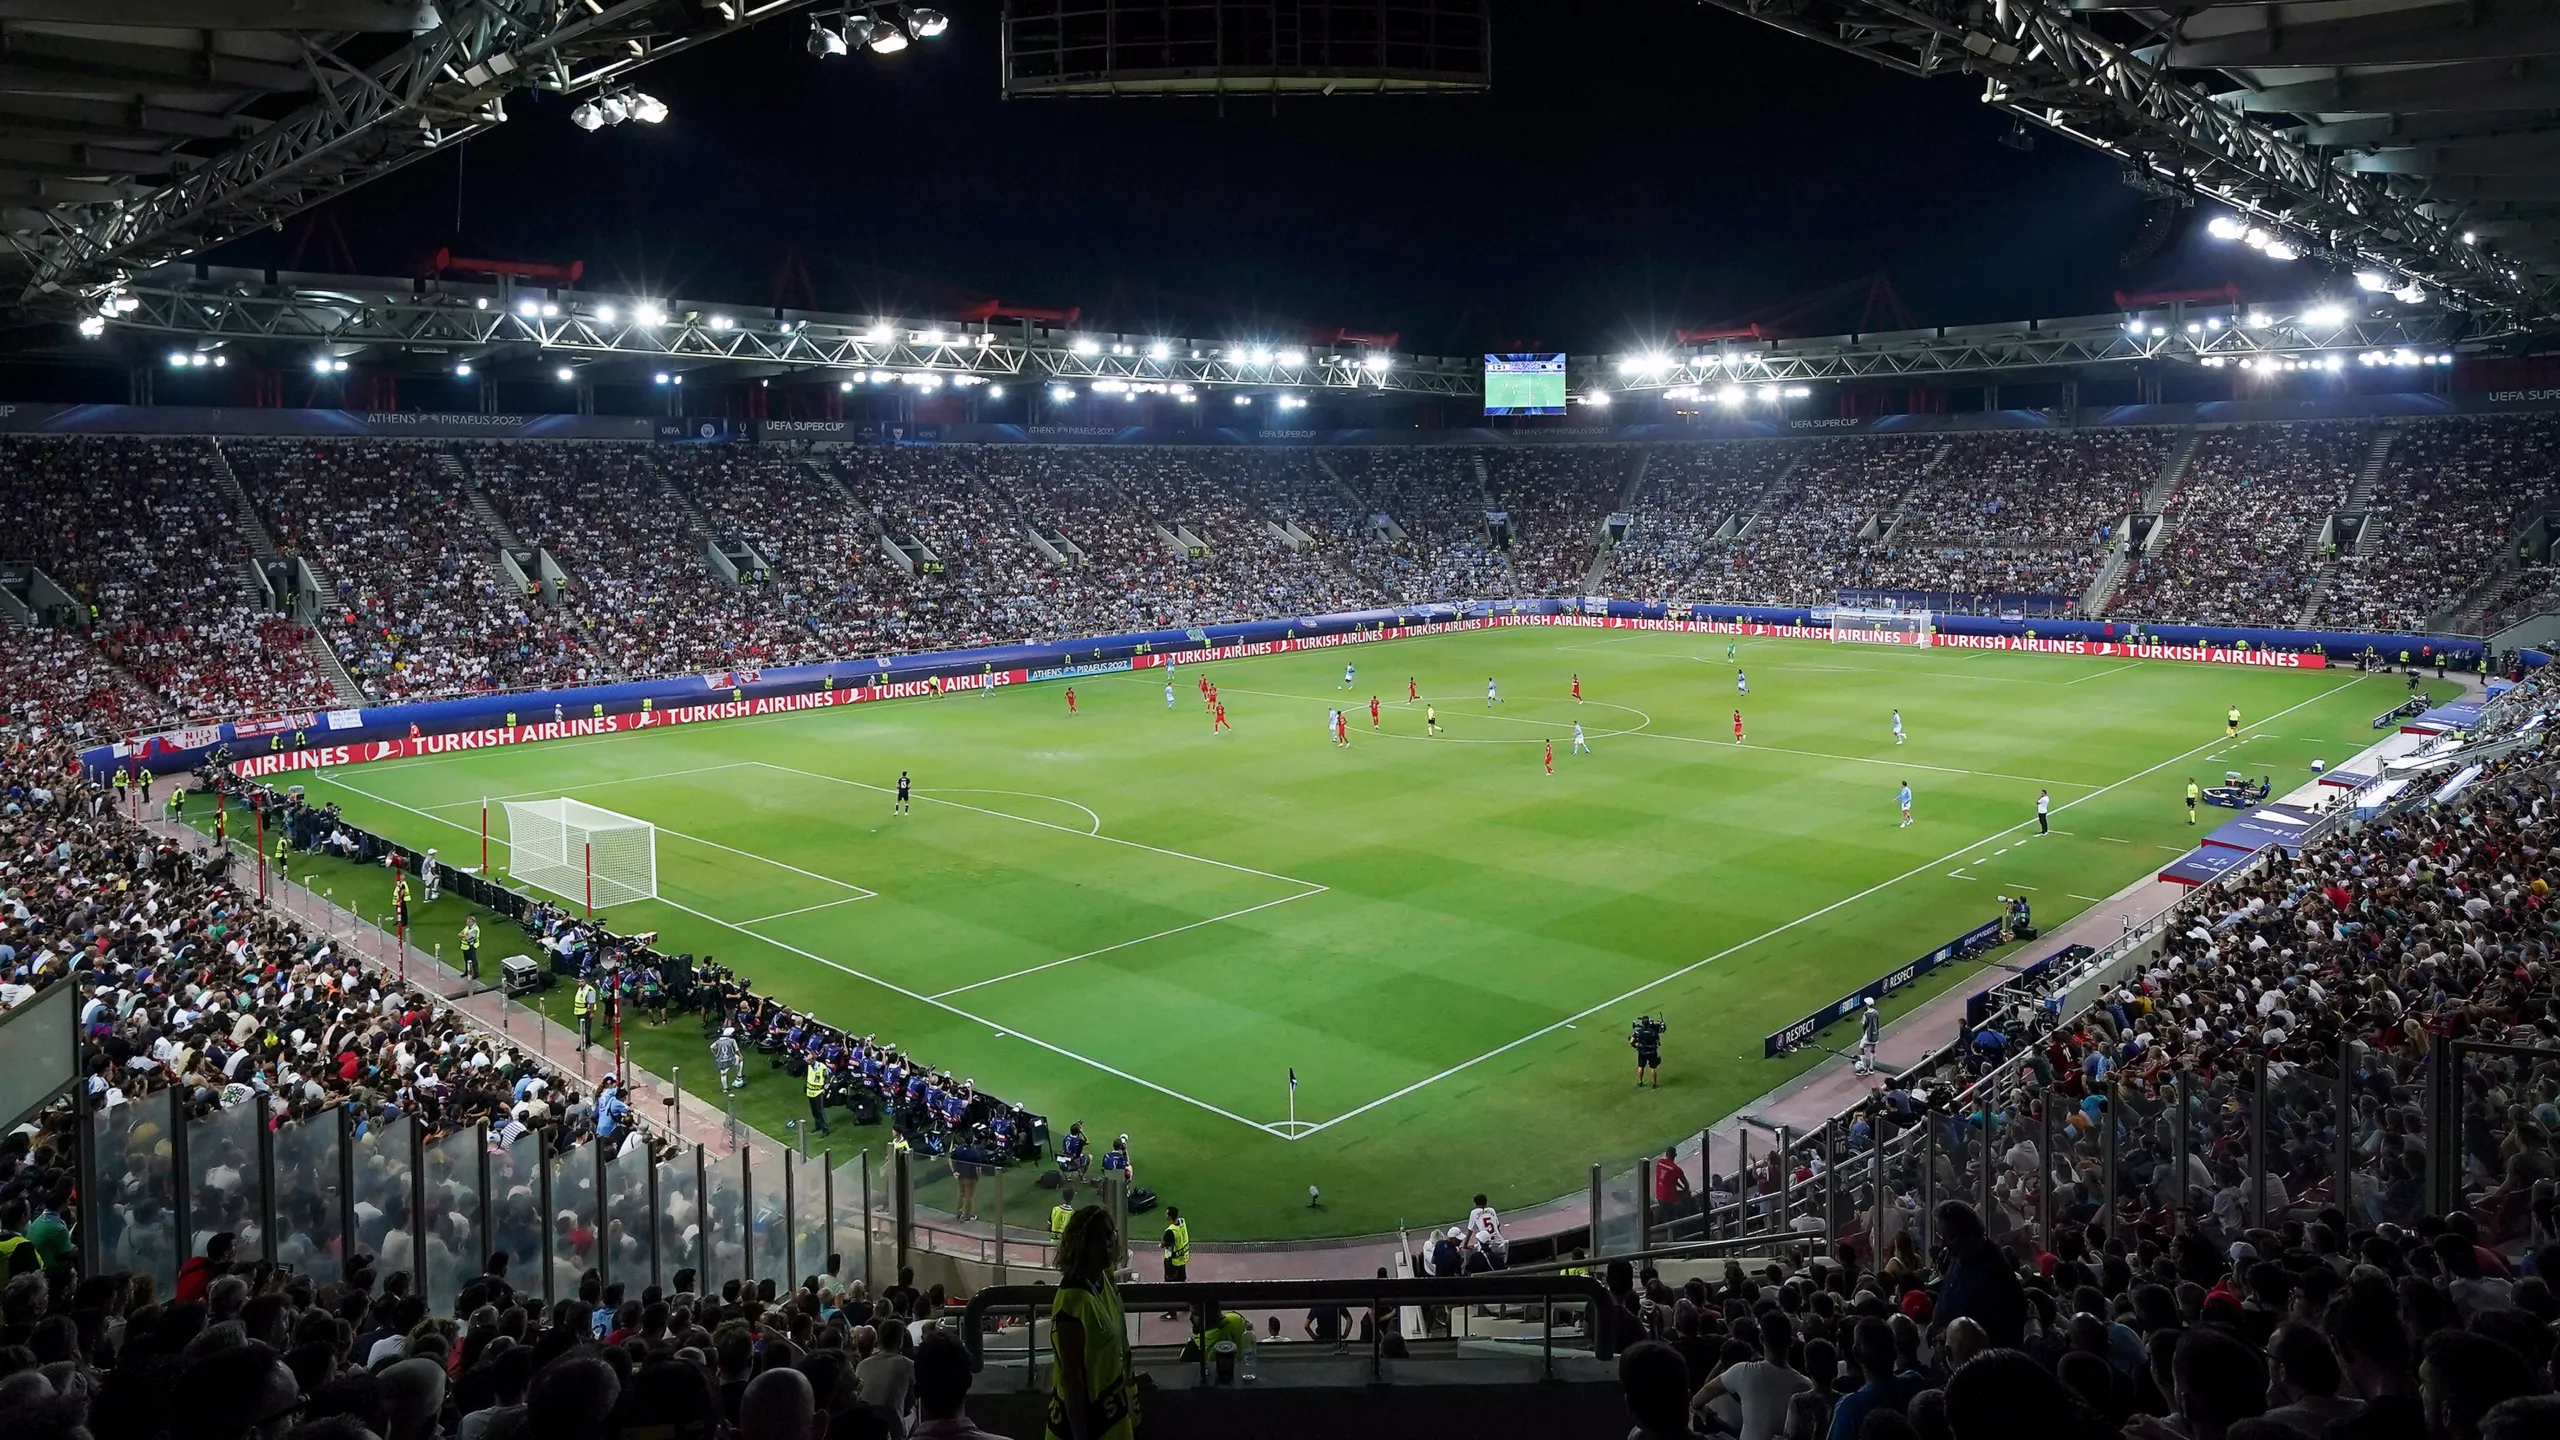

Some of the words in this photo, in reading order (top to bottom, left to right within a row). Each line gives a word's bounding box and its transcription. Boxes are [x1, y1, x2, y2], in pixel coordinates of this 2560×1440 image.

[2488, 390, 2525, 402] UEFA
[367, 412, 416, 424] ATHENS
[441, 414, 490, 426] PIRAEUS
[492, 416, 523, 426] 2023
[766, 420, 792, 432] UEFA
[794, 420, 825, 432] SUPER
[825, 421, 844, 432] CUP
[1790, 419, 1812, 429] UEFA
[1814, 418, 1840, 428] SUPER
[1840, 418, 1859, 427] CUP
[661, 427, 681, 435] UEFA
[1028, 426, 1056, 435] ATHENS
[1405, 623, 1443, 638] TURKISH
[1444, 618, 1481, 633] AIRLINES
[1500, 614, 1551, 627] TURKISH
[1553, 615, 1603, 628] AIRLINES
[1632, 618, 1684, 632] TURKISH
[1686, 619, 1743, 635] AIRLINES
[1296, 635, 1340, 651] TURKISH
[1341, 630, 1383, 647] AIRLINES
[1774, 625, 1832, 640] TURKISH
[1837, 628, 1901, 644] AIRLINES
[1172, 648, 1222, 665] TURKISH
[1223, 642, 1272, 660] AIRLINES
[1938, 634, 2006, 650] TURKISH
[2010, 637, 2085, 655] AIRLINES
[2126, 643, 2207, 662] TURKISH
[2211, 648, 2300, 667] AIRLINES
[1032, 668, 1063, 680] ATHENS
[1076, 663, 1108, 675] PIRAEUS
[1108, 660, 1128, 671] 2023
[668, 700, 751, 724] TURKISH
[756, 691, 834, 716] AIRLINES
[412, 727, 515, 756] TURKISH
[522, 715, 618, 743] AIRLINES
[241, 745, 350, 779] AIRLINES
[1889, 965, 1915, 988] RESPECT
[1785, 1018, 1816, 1045] RESPECT
[1835, 1140, 1846, 1155] 16
[1482, 1217, 1495, 1234] 5
